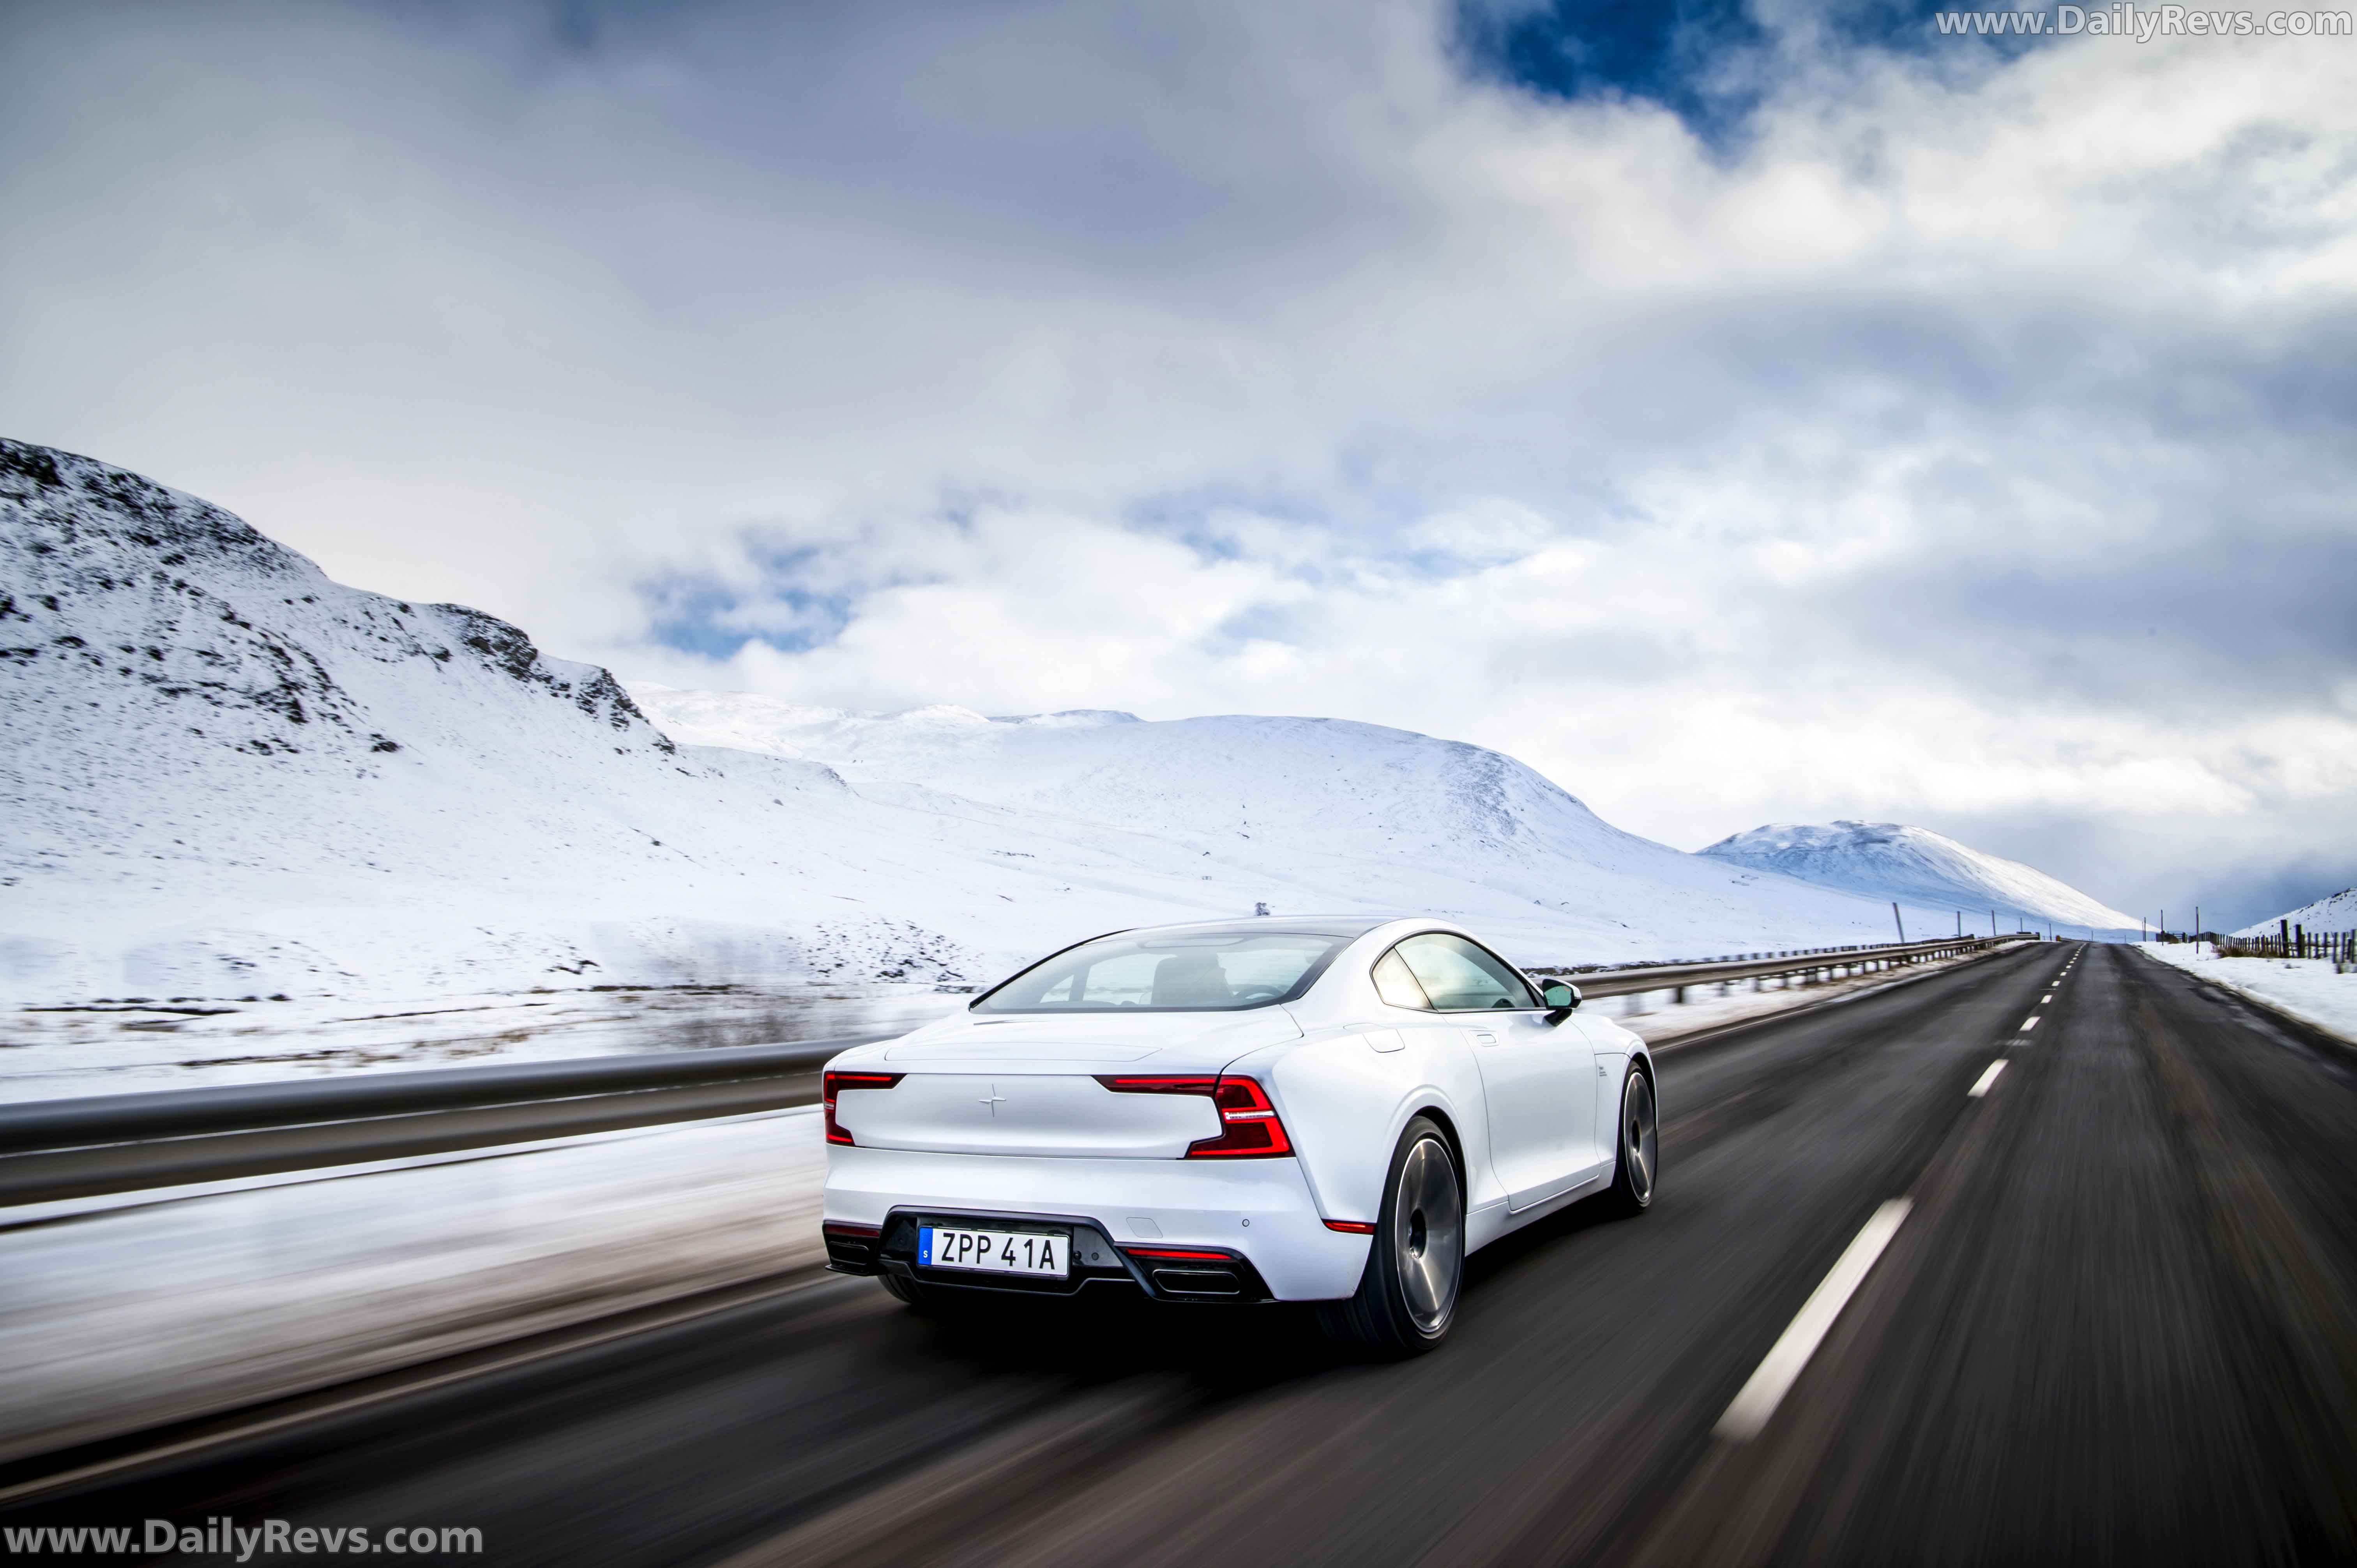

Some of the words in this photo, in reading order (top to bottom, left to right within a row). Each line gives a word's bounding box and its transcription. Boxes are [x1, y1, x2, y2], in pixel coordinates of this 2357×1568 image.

[923, 1250, 928, 1258] S
[942, 1232, 991, 1264] ZPP
[1001, 1237, 1055, 1270] 41A
